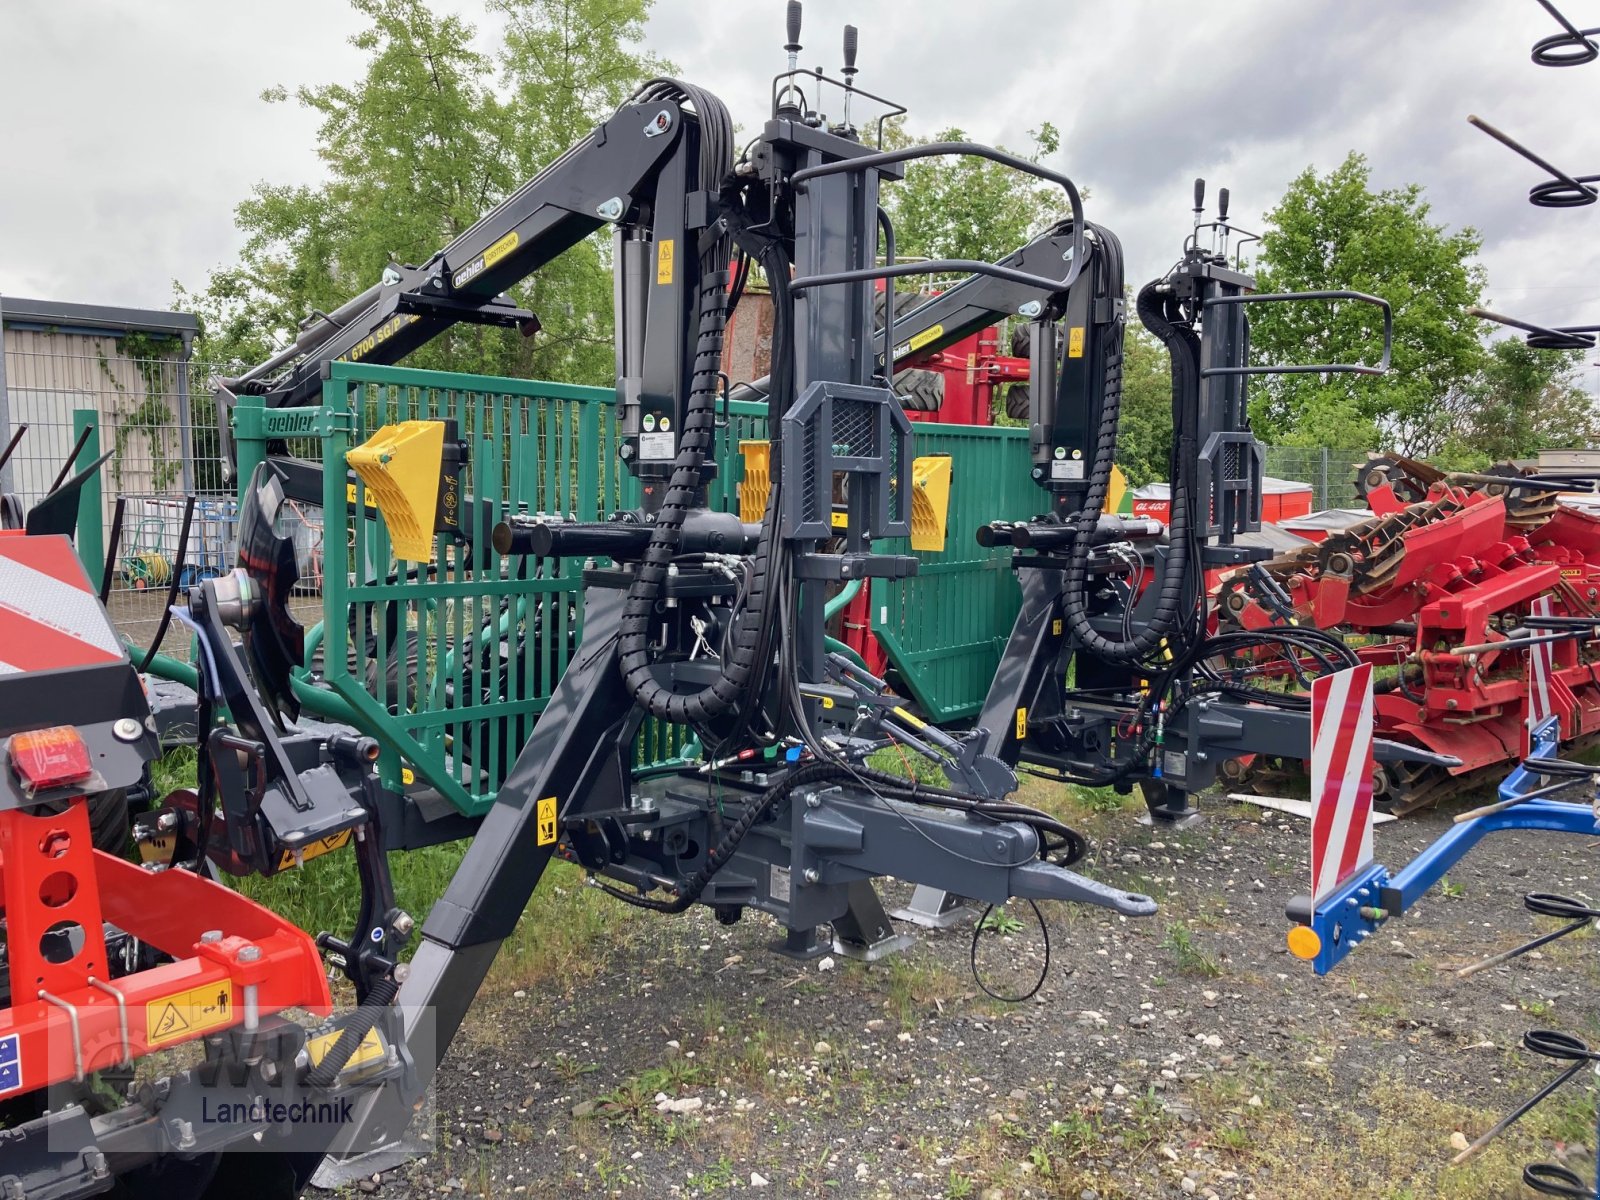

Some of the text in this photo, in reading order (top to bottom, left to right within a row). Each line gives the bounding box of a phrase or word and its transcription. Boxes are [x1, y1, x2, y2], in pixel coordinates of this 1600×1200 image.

[455, 258, 484, 287] oehler
[351, 336, 375, 361] 6700
[268, 413, 314, 432] oehler
[1148, 503, 1167, 511] 403
